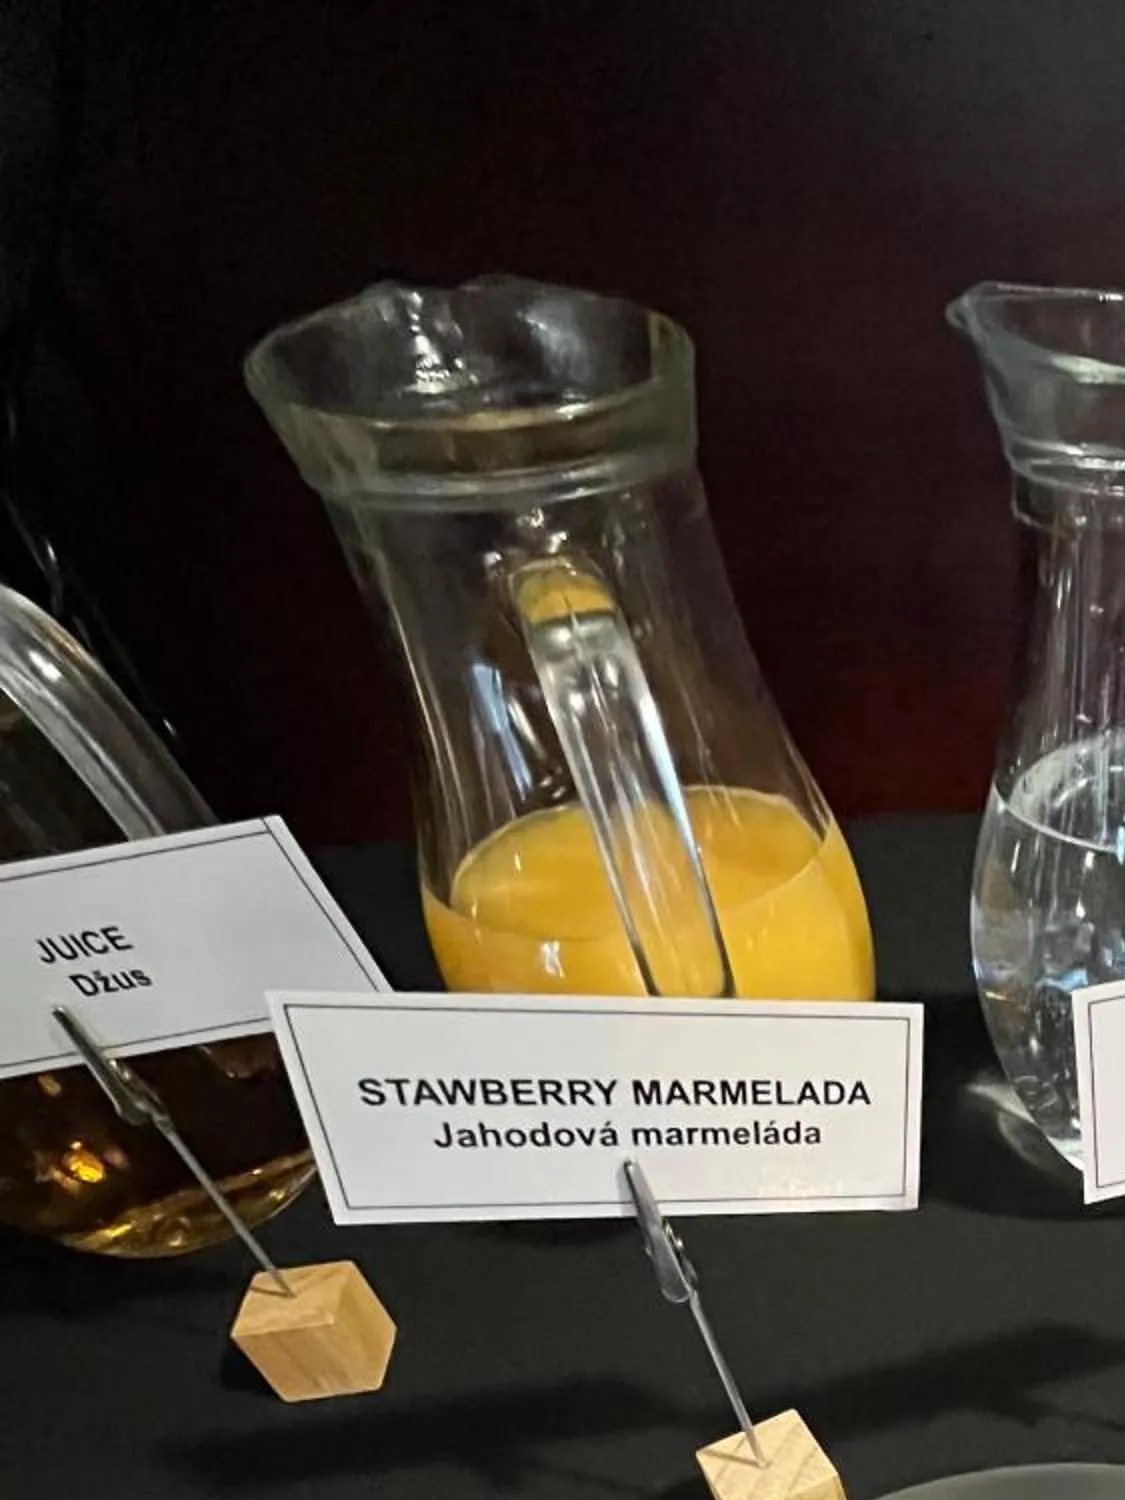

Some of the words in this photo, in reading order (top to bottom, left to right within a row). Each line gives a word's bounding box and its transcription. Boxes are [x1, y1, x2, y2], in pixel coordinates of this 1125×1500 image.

[35, 925, 134, 964] JUICE
[68, 968, 153, 997] Džus
[358, 1078, 617, 1108] STAWBERRY
[631, 1079, 870, 1107] MARMELADA
[433, 1119, 618, 1149] Jahodová
[631, 1120, 822, 1146] marmeláda
